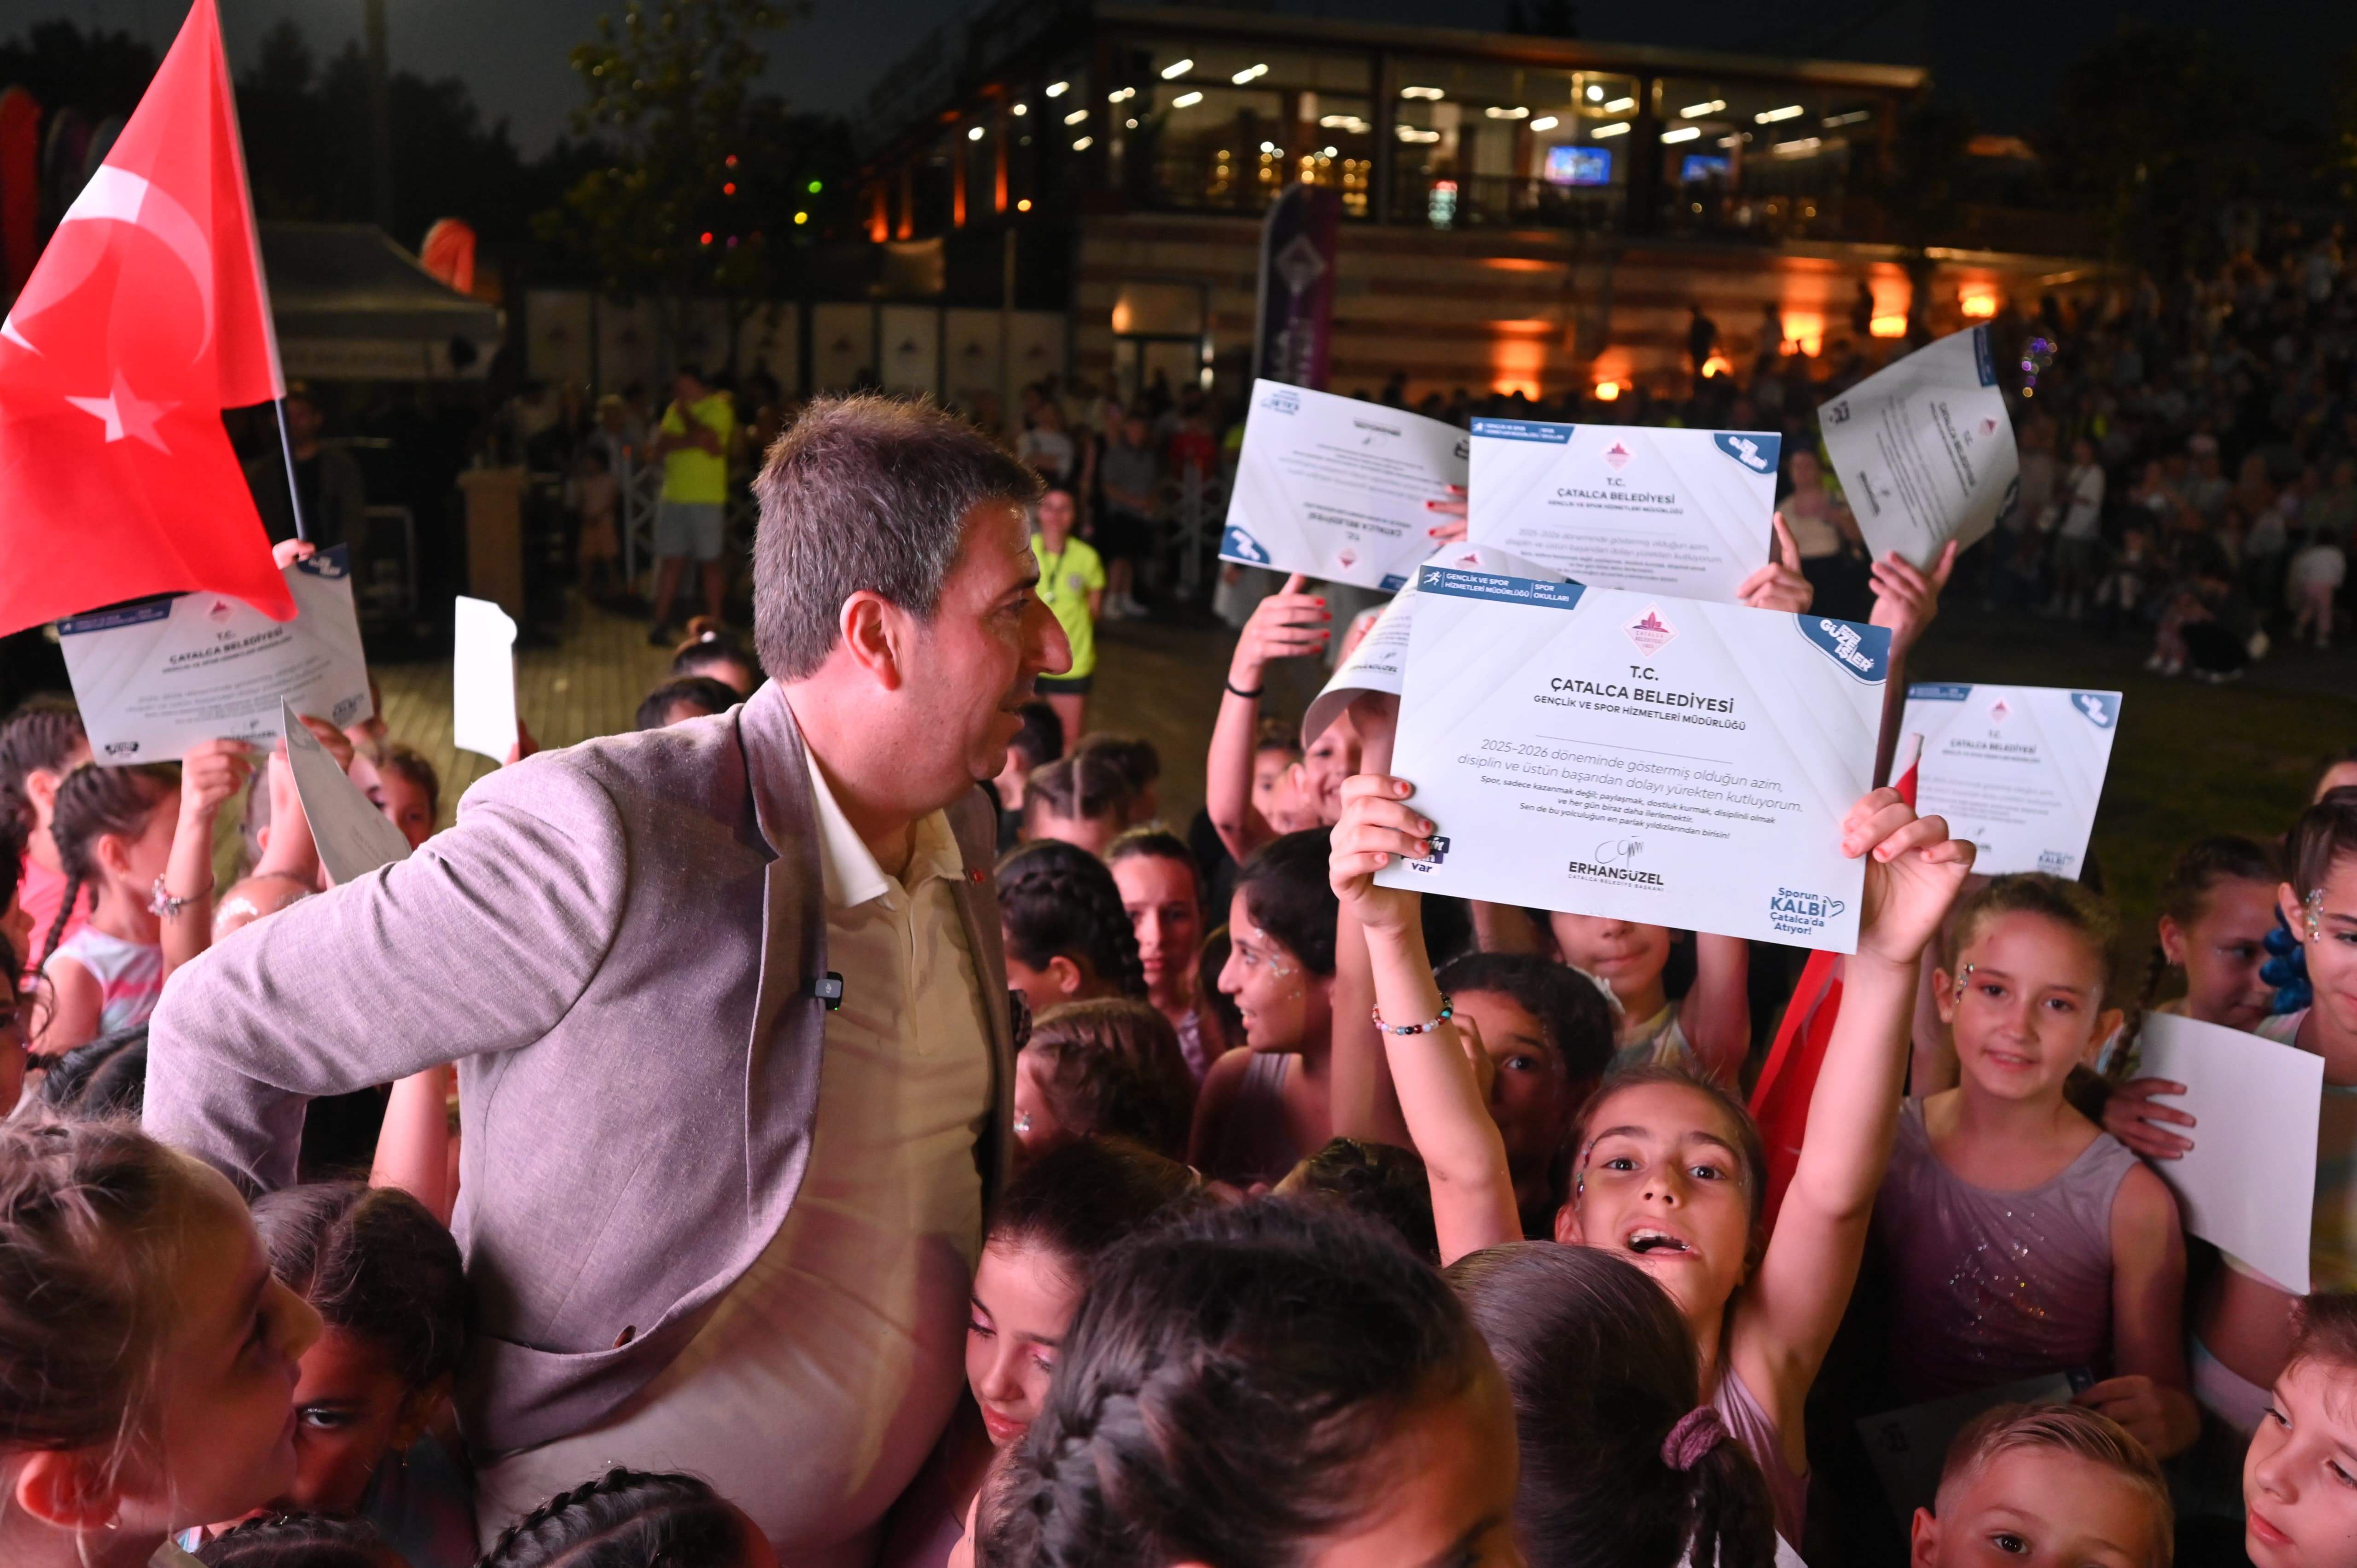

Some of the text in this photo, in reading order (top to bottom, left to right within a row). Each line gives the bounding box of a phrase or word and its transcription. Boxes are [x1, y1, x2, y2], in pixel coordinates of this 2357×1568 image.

[1607, 477, 1626, 487] T.C.
[1557, 488, 1676, 504] ÇATALCA BELEDİYESİ
[1446, 573, 1477, 583] GENÇLİK
[1445, 581, 1530, 597] HİZMETLERİ MÜDÜRLÜĞÜ
[1533, 592, 1569, 602] OKULLARI
[1630, 665, 1659, 681] T.C.
[1550, 677, 1735, 714] ÇATALCA BELEDİYESİ
[1533, 695, 1746, 731] GENÇLİK VE SPOR HİZMETLERİ MÜDÜRLÜĞÜ
[1480, 738, 1783, 793] 2025-2026 döneminde göstermiş olduğun azim,
[1457, 753, 1804, 813] disiplin ve üstün başarıdan dolayı yürekten kutluyorum.
[1480, 775, 1501, 785] Spor,
[1503, 778, 1532, 789] sadece
[1533, 783, 1573, 795] kazanmak
[1599, 793, 1644, 807] paylaşmak,
[1647, 800, 1677, 810] dostluk
[1679, 804, 1712, 816] kurmak,
[1714, 809, 1749, 821] disiplinli
[1749, 814, 1776, 824] olmak
[1569, 799, 1583, 807] her
[1584, 801, 1601, 810] gün
[1602, 803, 1622, 813] biraz
[1624, 807, 1643, 816] daha
[1645, 809, 1694, 823] ilerlemektir.
[1520, 802, 1535, 811] Sen
[1549, 807, 1560, 815] bu
[1560, 809, 1606, 822] yolculuğun
[1618, 816, 1644, 827] parlak
[1645, 820, 1701, 836] yıldızlarından
[1702, 828, 1730, 839] birisin!
[1411, 862, 1433, 873] var
[1569, 861, 1664, 886] ERHANGÜZEL
[1778, 887, 1818, 900] Sporun
[1771, 896, 1827, 918] KALBİ
[1770, 912, 1825, 927] Çatalca'da
[1774, 922, 1812, 935] Atıyor!
